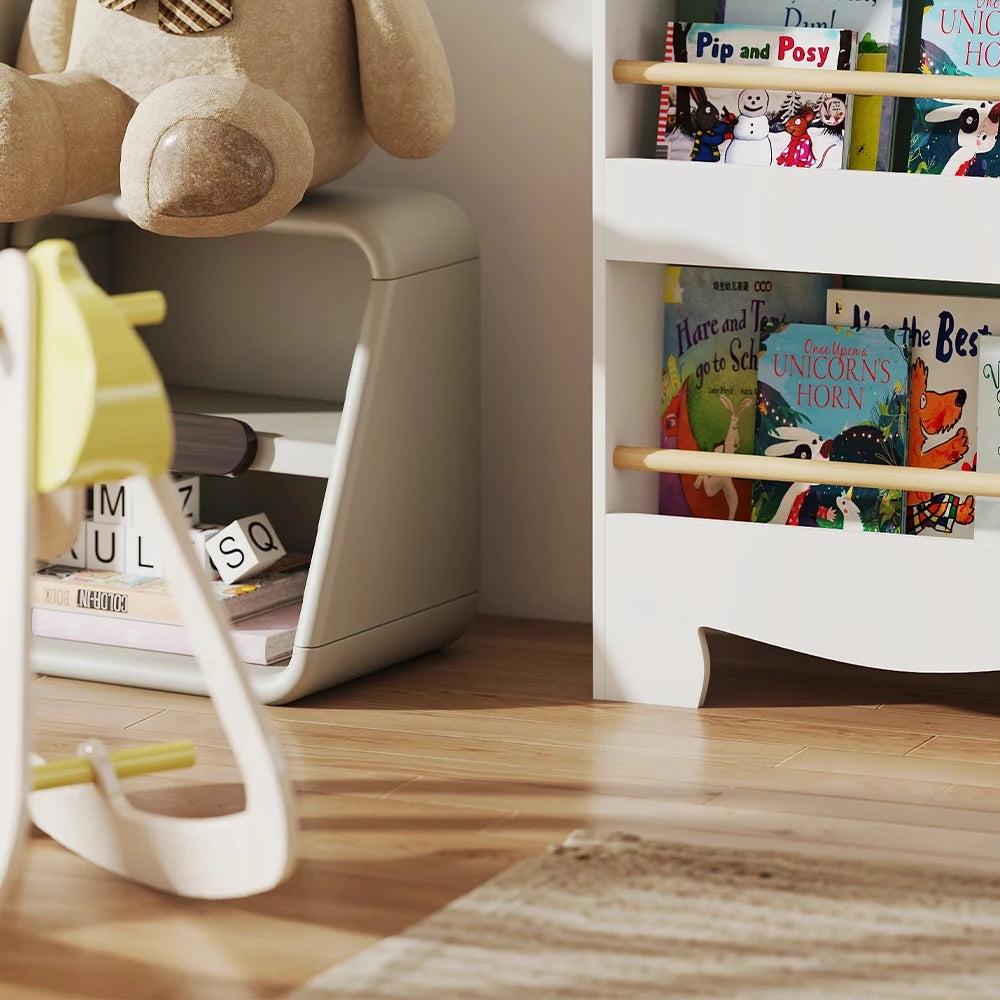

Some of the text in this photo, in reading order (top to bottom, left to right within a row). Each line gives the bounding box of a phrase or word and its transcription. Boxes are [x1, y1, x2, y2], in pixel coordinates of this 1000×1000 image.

[696, 31, 830, 68] Pip and Posy
[676, 316, 719, 358] Hare
[722, 308, 747, 333] and
[804, 338, 869, 360] Once Upon a
[695, 337, 758, 390] go to Sch
[773, 353, 891, 384] UNICORN'S
[796, 382, 864, 411] HORN
[100, 484, 125, 517] M
[95, 530, 115, 563] U
[138, 536, 154, 569] L
[219, 536, 245, 569] S
[248, 521, 279, 552] Q
